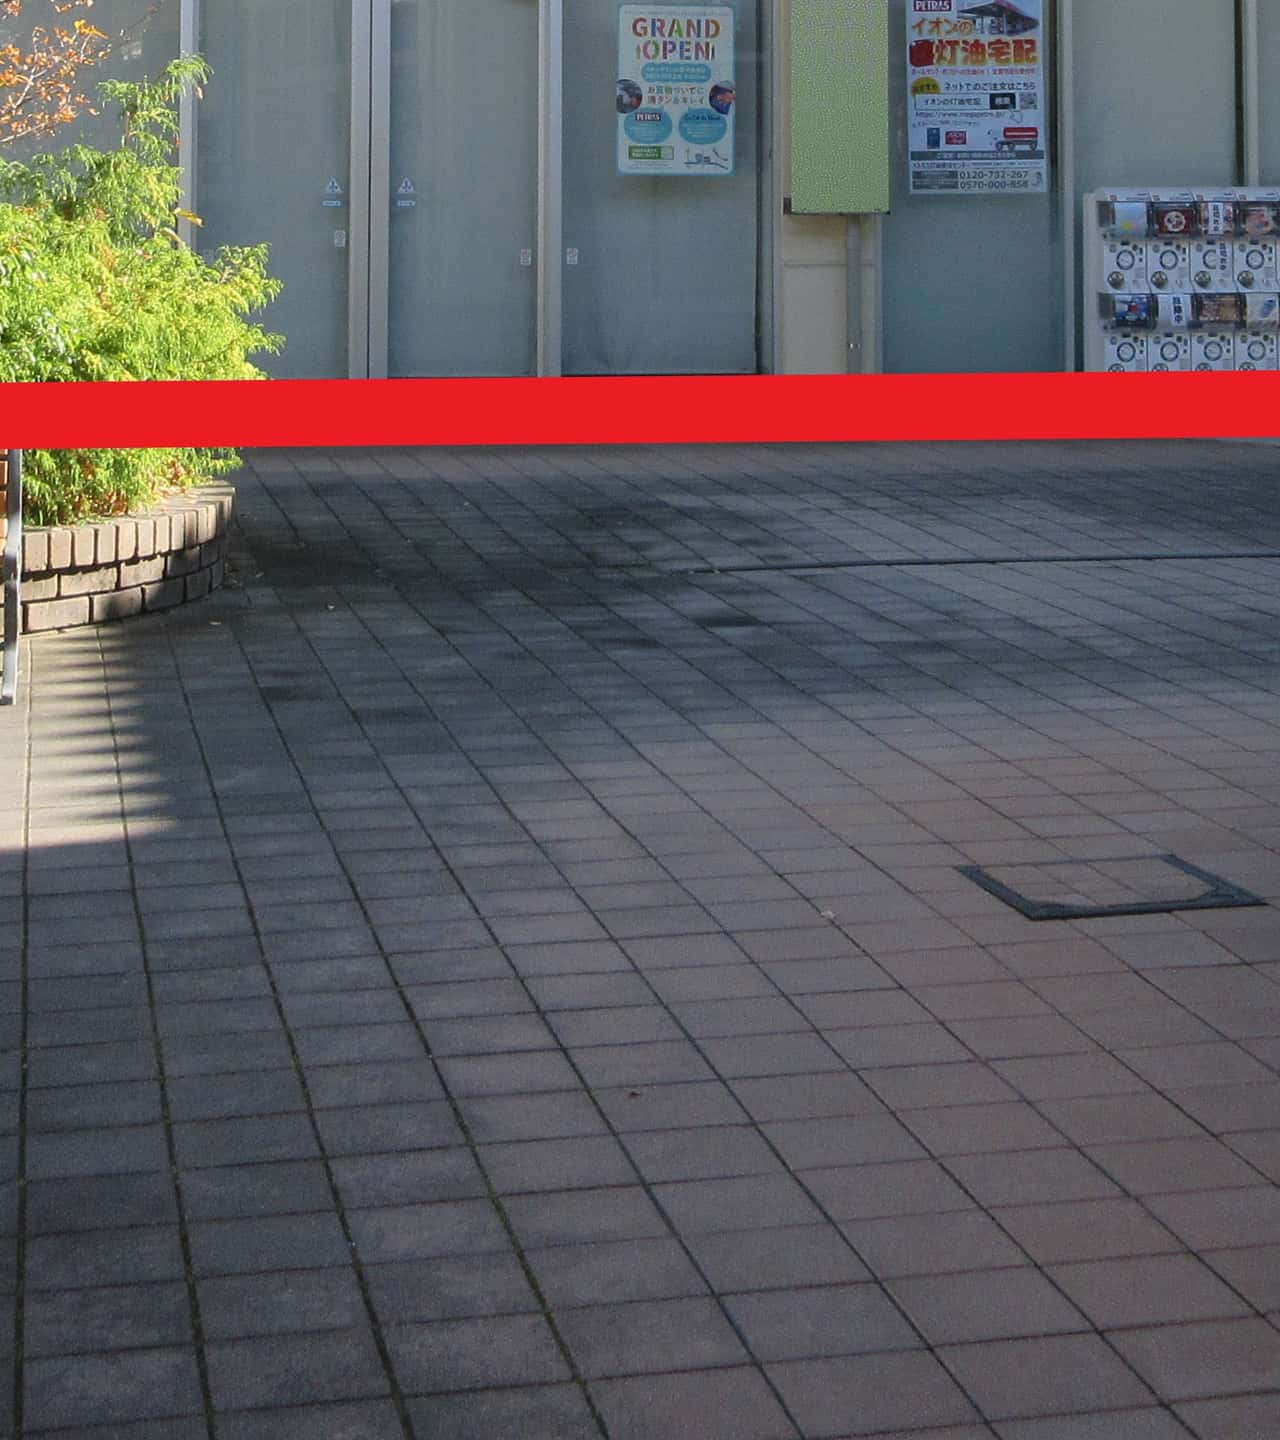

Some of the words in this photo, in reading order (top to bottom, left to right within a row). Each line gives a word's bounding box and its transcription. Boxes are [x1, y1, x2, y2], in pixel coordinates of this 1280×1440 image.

[631, 16, 721, 39] GRAND
[911, 17, 974, 36] イオンの
[640, 39, 713, 61] OPEN
[933, 38, 1038, 66] 灯油宅配
[944, 81, 1037, 91] ネットでのご注文はこちら
